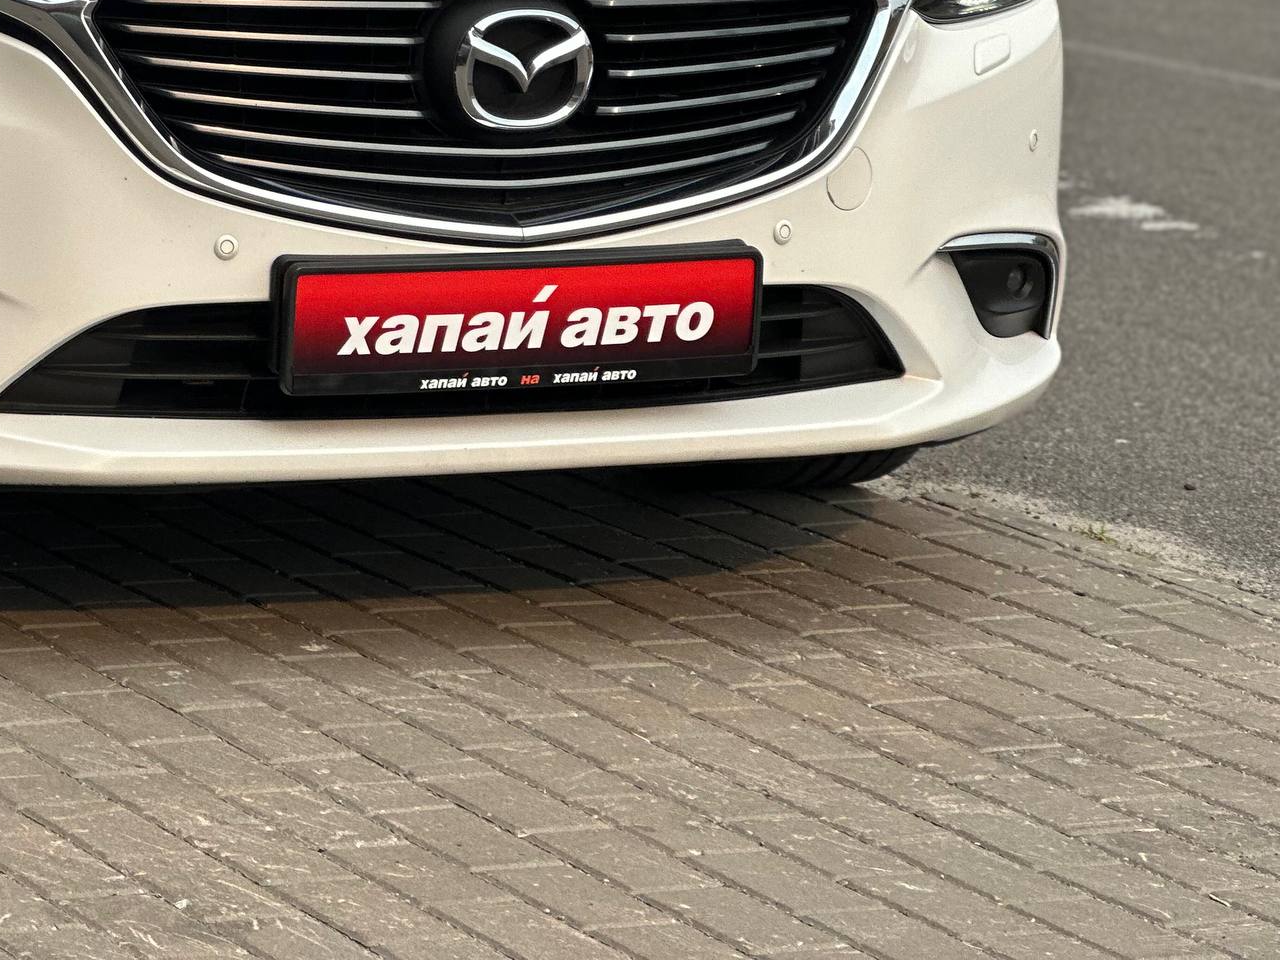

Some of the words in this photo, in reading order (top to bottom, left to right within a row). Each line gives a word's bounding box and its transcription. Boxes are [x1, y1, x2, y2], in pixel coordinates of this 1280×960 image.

[561, 302, 715, 348] авто
[471, 375, 508, 388] авто
[520, 373, 541, 385] на
[601, 368, 637, 382] авто
